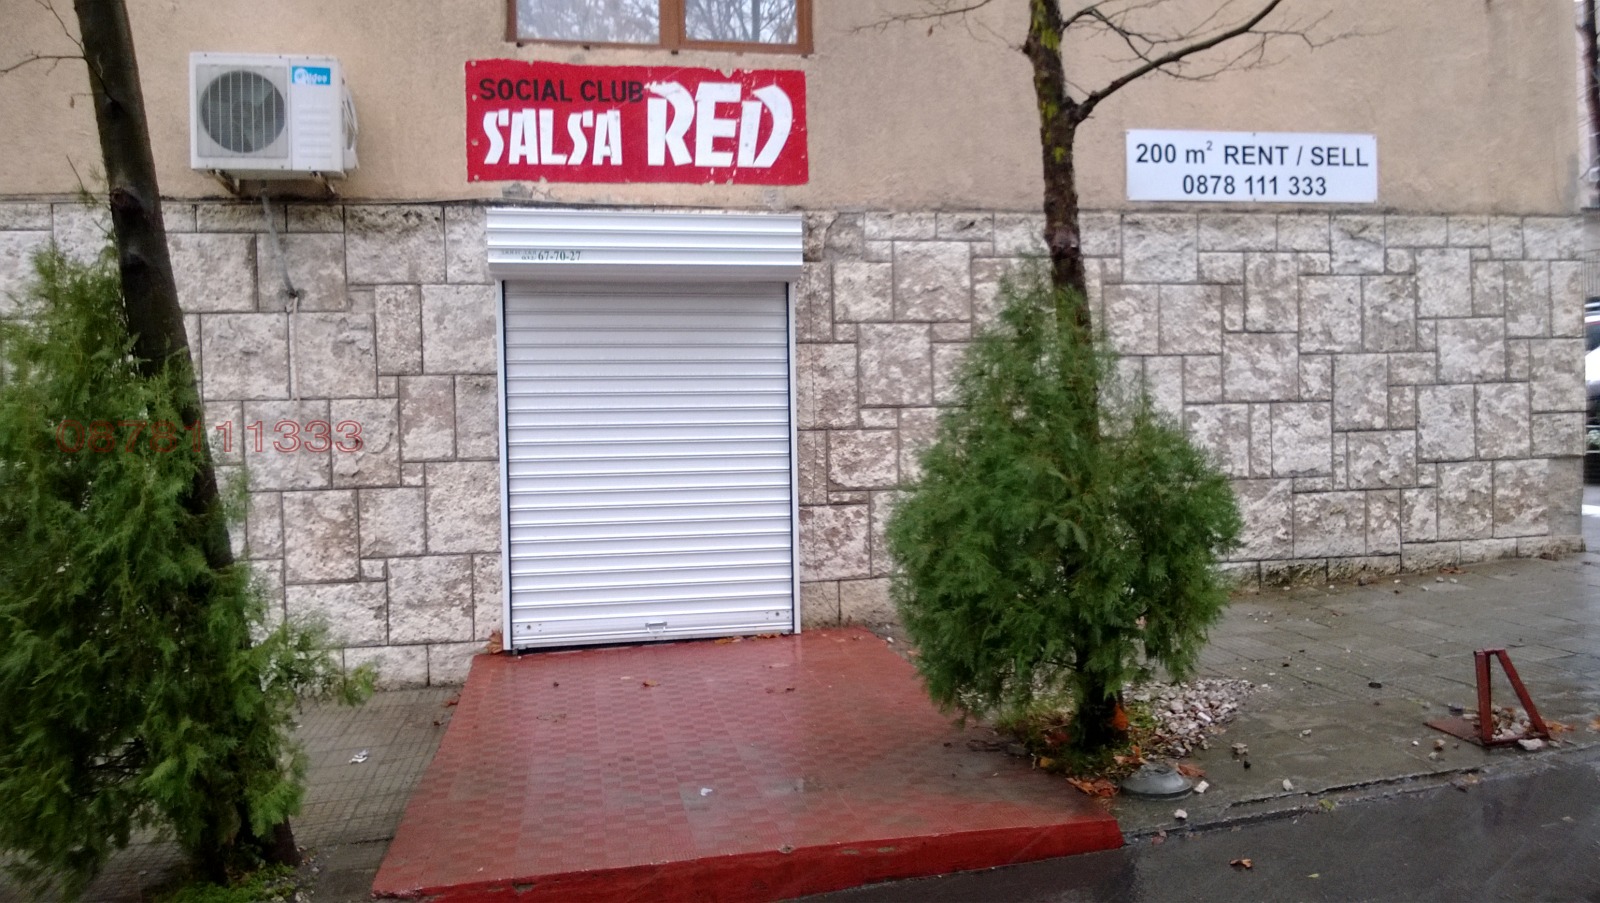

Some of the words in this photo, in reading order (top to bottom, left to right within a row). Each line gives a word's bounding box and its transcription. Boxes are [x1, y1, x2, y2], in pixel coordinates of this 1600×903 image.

[479, 78, 573, 103] SOCIAL
[580, 80, 644, 104] CLUB
[482, 108, 623, 166] SALSA
[644, 81, 794, 168] RED
[1136, 143, 1176, 163] 200
[1224, 145, 1289, 166] RENT
[1310, 146, 1369, 167] SELL
[1182, 174, 1236, 195] 0878
[1244, 175, 1278, 195] 111
[1288, 176, 1327, 196] 333
[538, 250, 581, 261] 67-70-27
